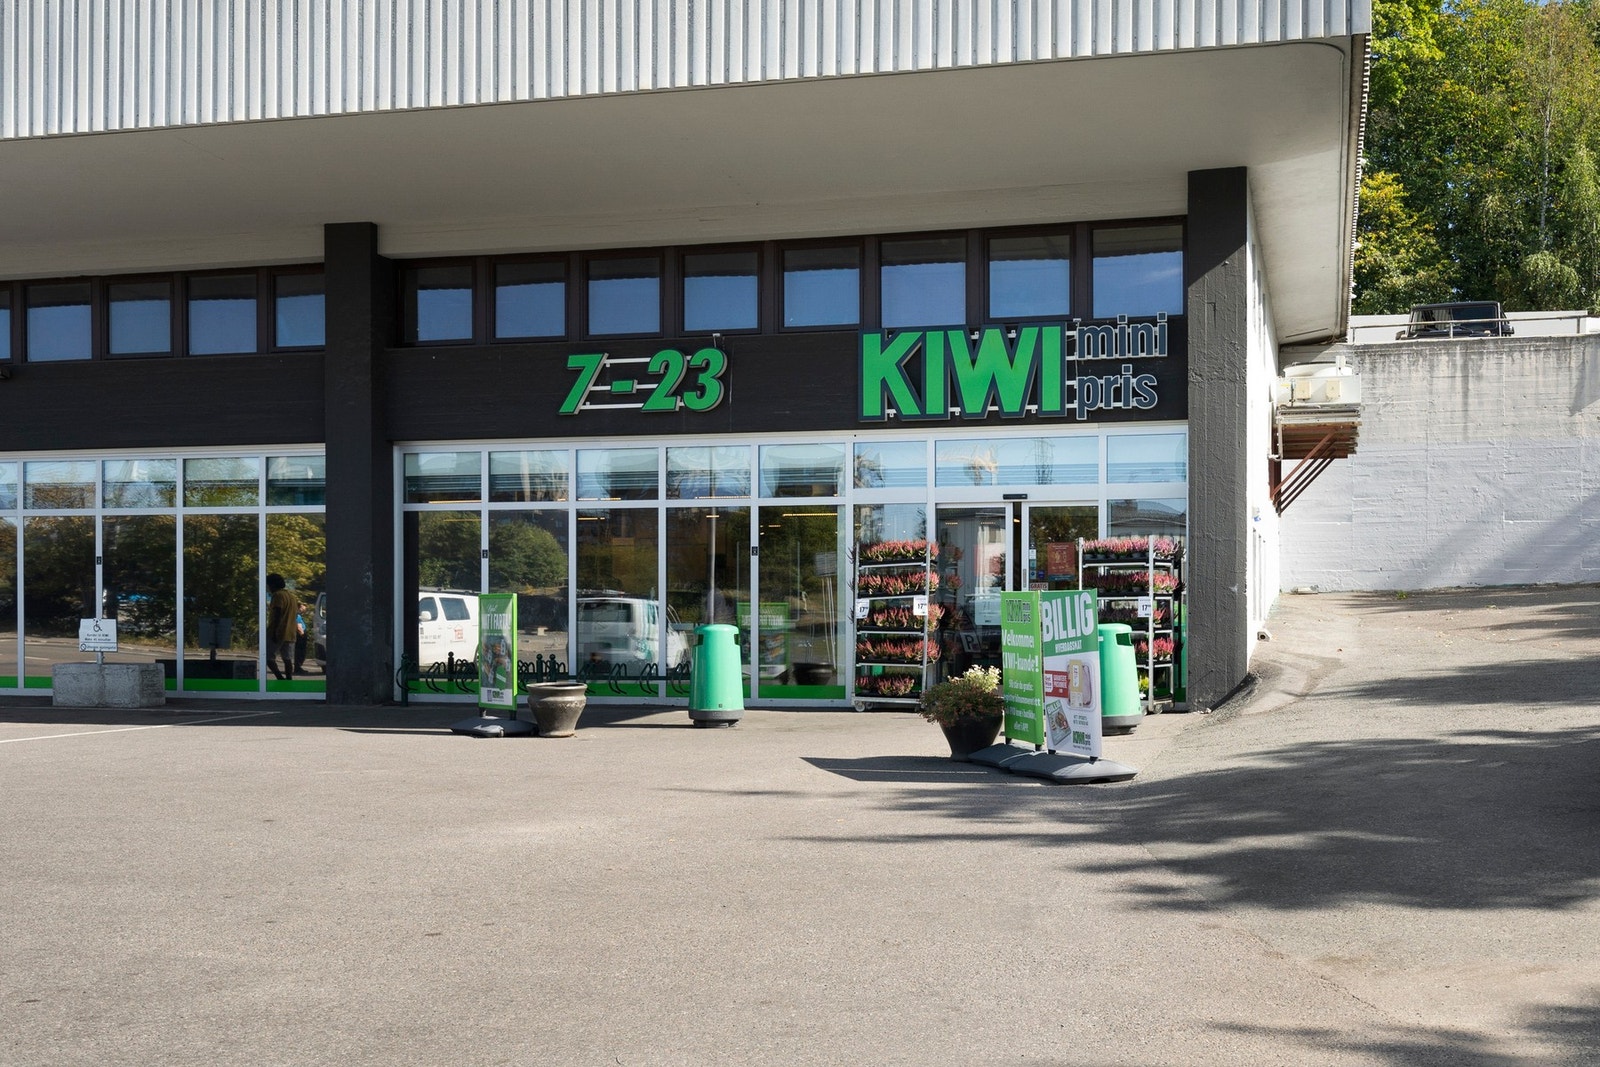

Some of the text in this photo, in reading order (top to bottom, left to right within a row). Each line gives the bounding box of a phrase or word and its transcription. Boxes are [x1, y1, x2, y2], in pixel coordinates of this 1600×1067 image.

[1076, 311, 1168, 360] mini
[558, 347, 728, 415] 7-23
[859, 322, 1067, 422] KIWI
[1076, 364, 1158, 420] pris
[1041, 592, 1095, 642] BILLIG
